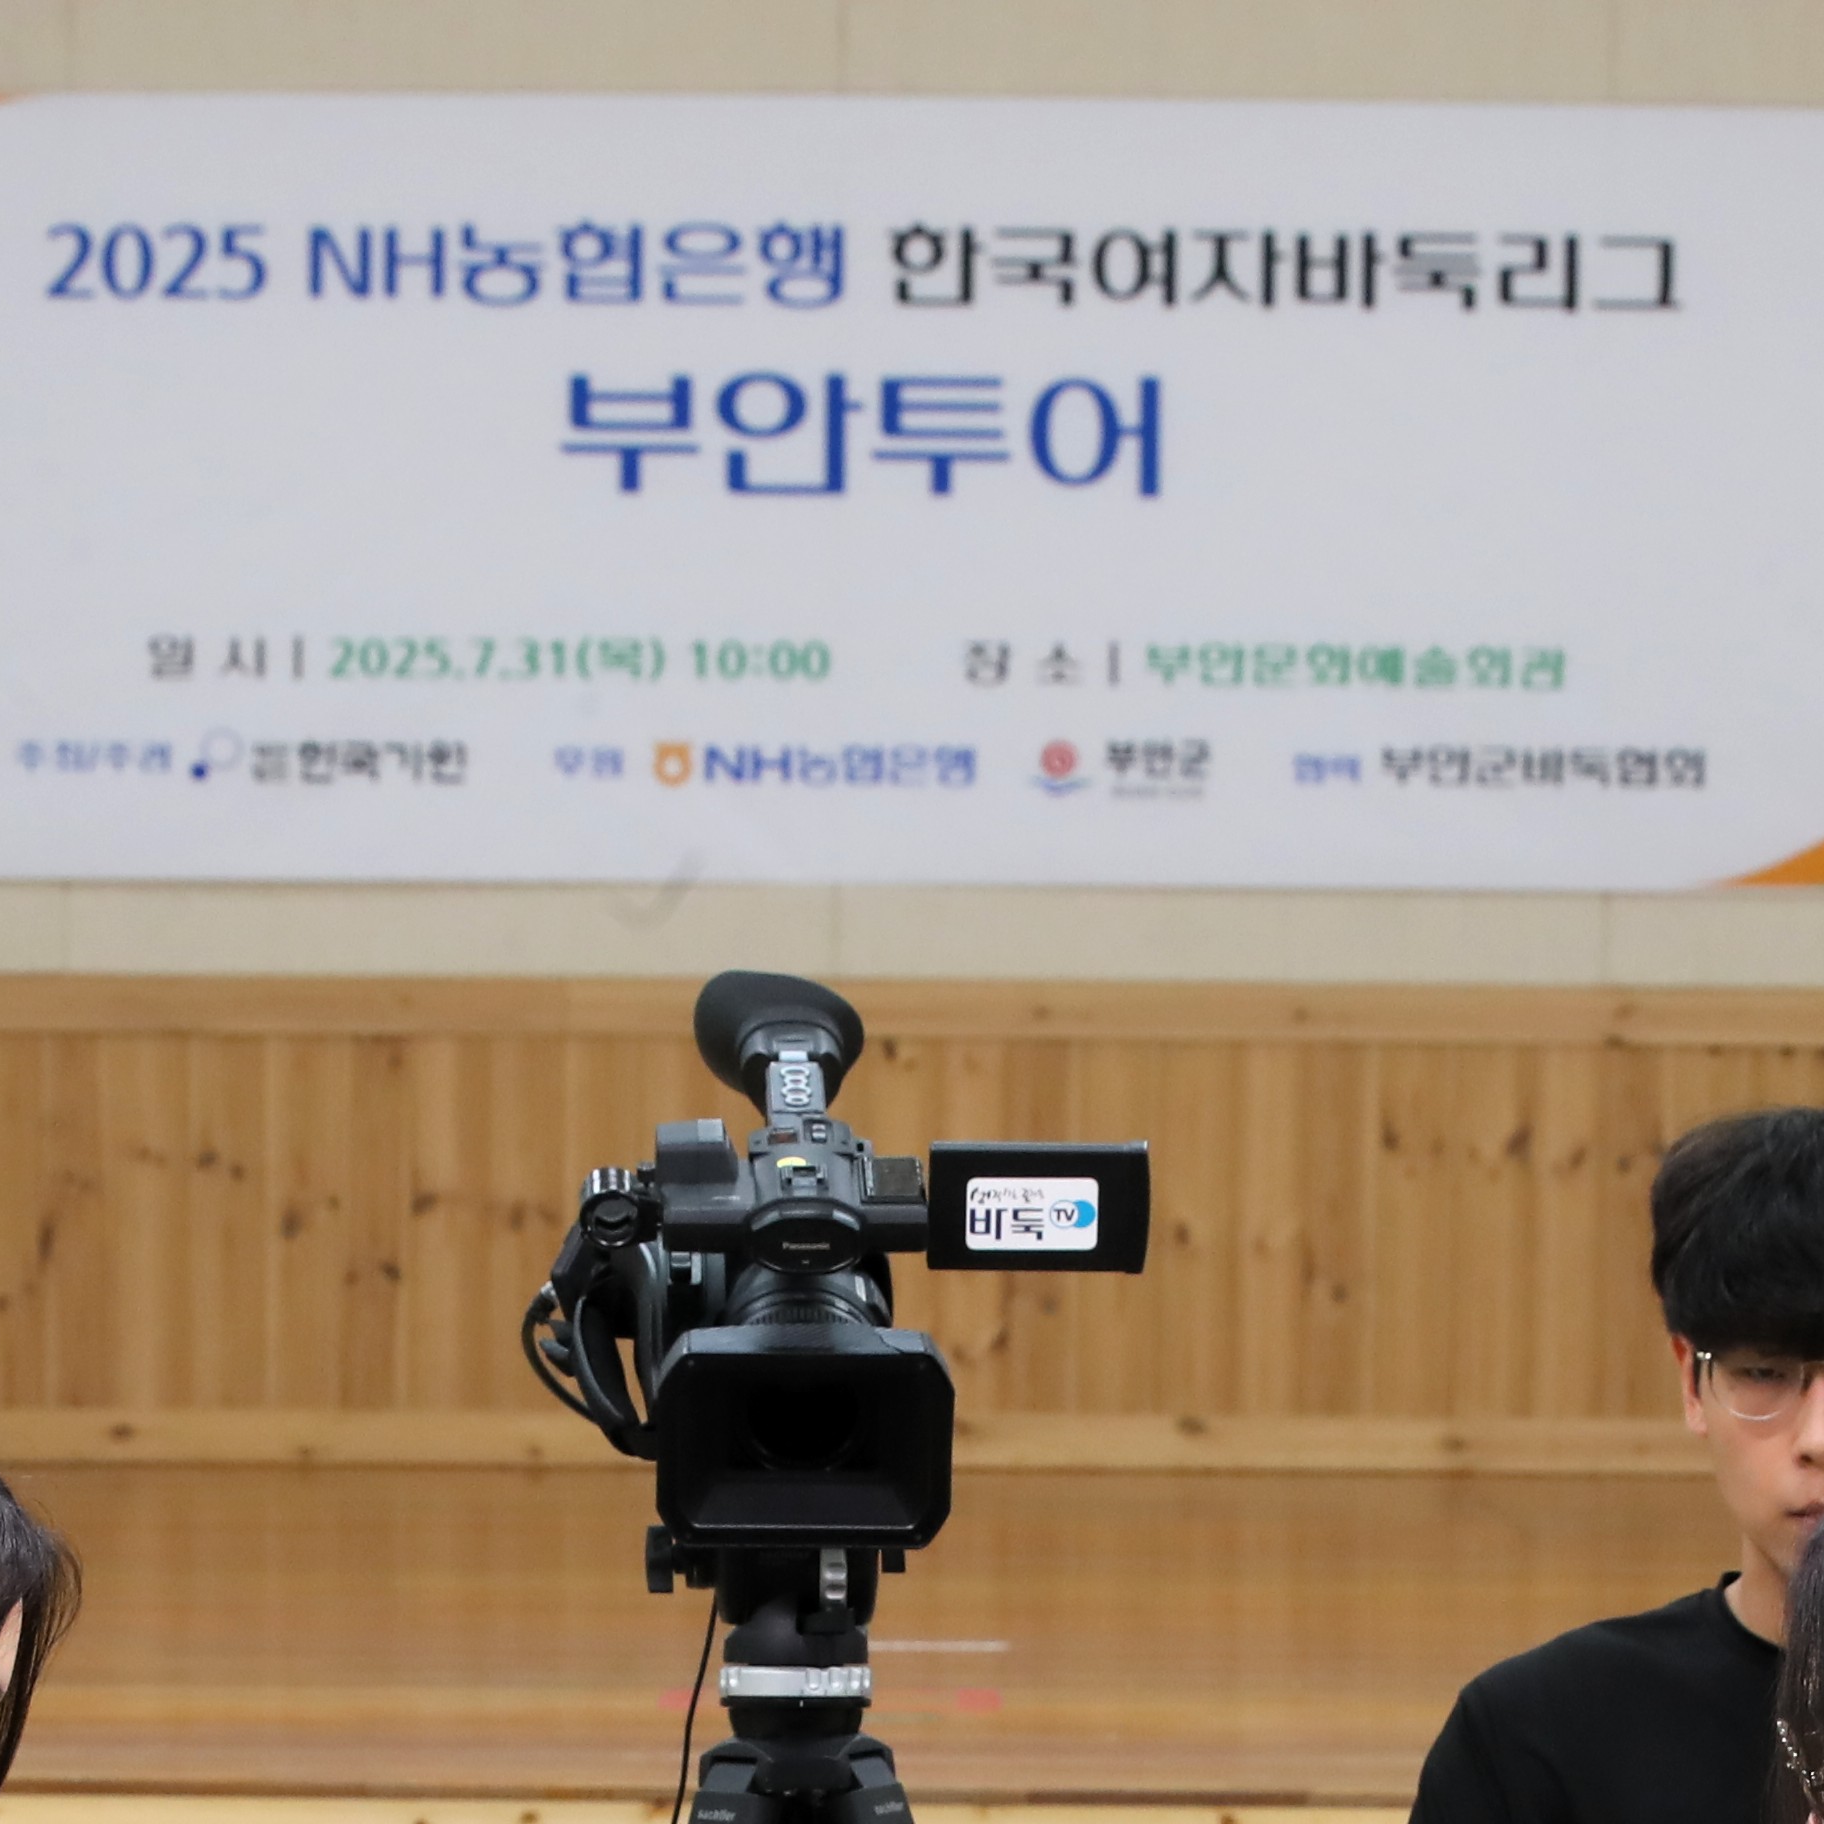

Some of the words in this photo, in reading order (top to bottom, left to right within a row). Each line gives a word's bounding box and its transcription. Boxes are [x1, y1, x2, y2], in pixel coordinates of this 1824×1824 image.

[46, 223, 268, 300] 2025
[307, 220, 846, 308] NH농협은행
[890, 223, 1677, 314] 한국여자바둑리그
[563, 371, 1162, 499] 부안투어
[328, 636, 667, 683] 2025.7.31(목)
[691, 639, 833, 682] 10:00
[1145, 642, 1567, 692] 부안문화예술회관
[702, 744, 978, 786] NH농협은행
[968, 1208, 1044, 1241] 바둑
[1053, 1206, 1076, 1224] TV
